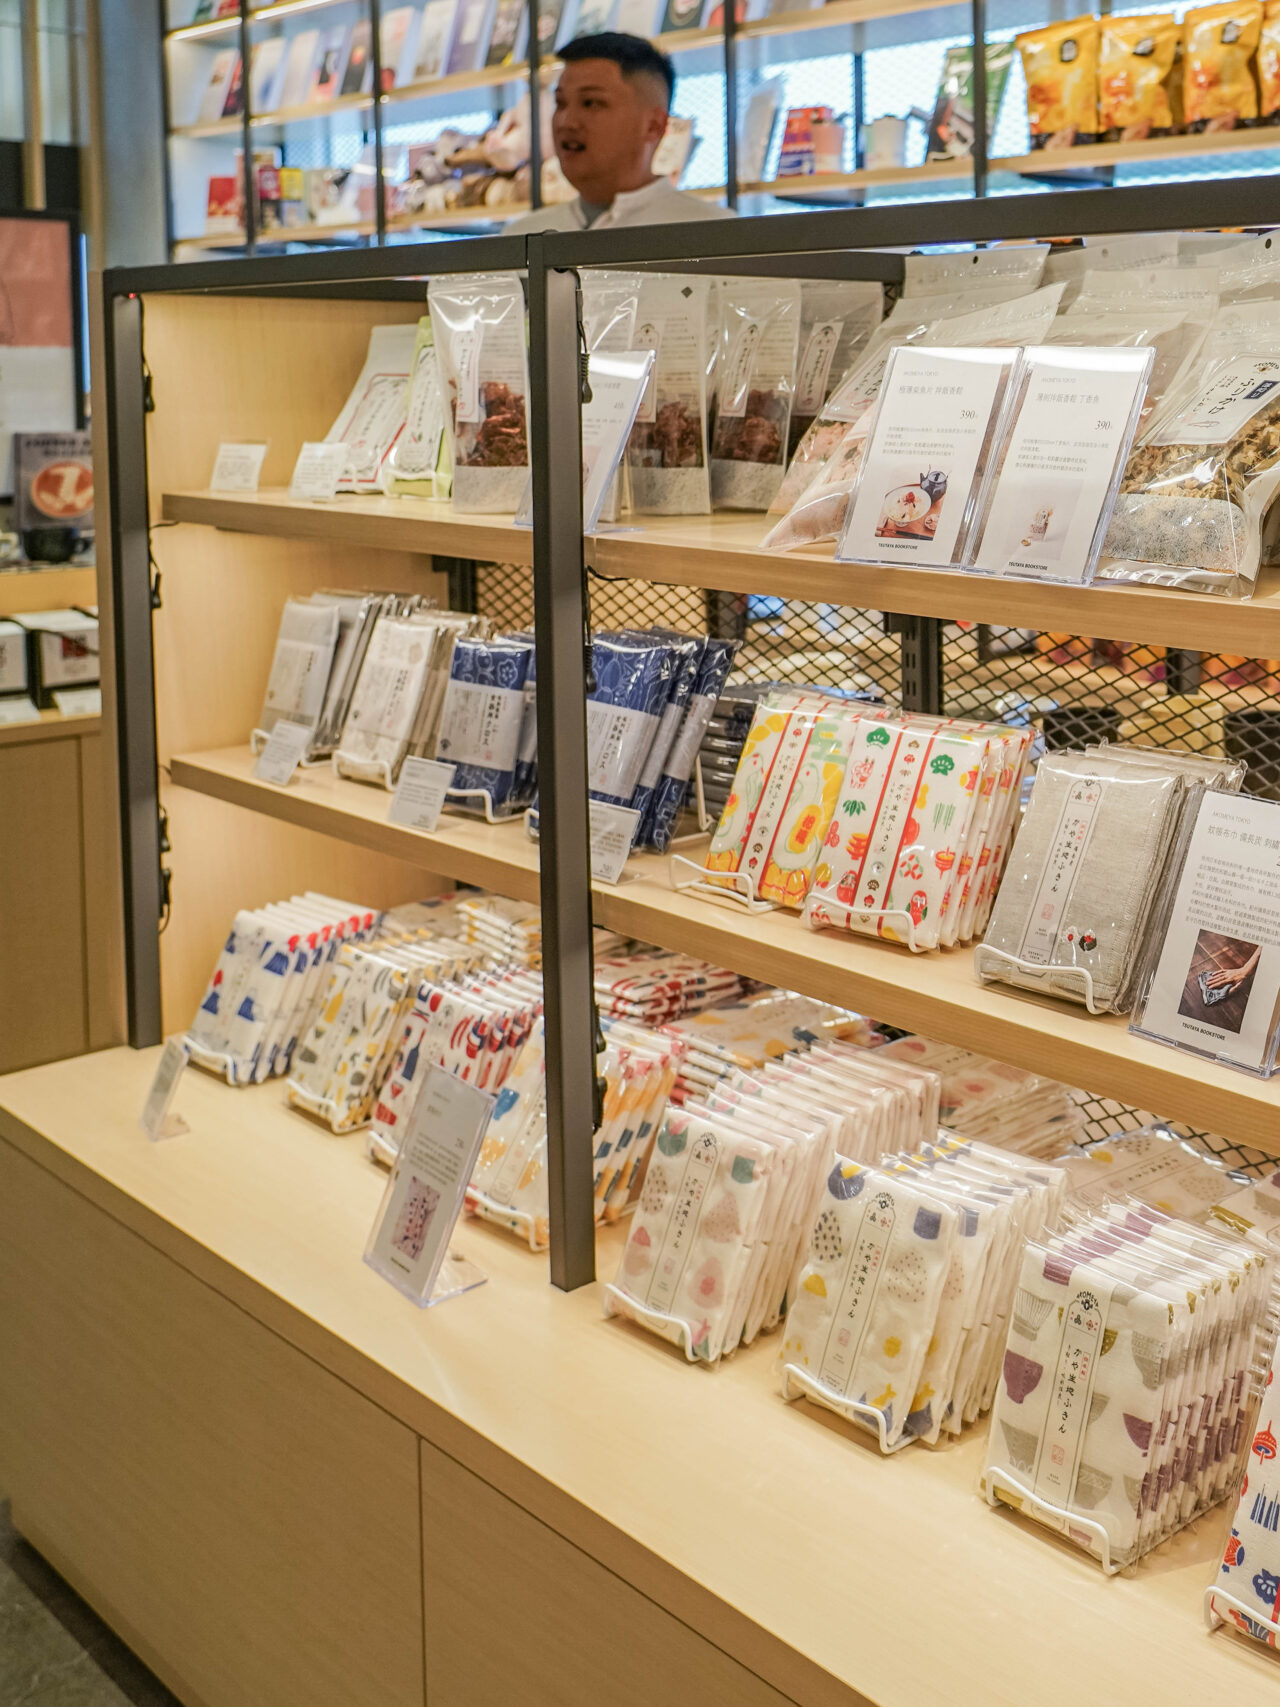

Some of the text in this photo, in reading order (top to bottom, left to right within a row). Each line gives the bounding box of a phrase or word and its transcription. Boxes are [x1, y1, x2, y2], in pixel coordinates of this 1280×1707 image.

[1208, 378, 1255, 415] ふりかけ
[960, 410, 975, 419] 390
[1095, 421, 1111, 430] 390
[1182, 1022, 1225, 1041] TSUTAYA BOOKSTORE
[1058, 1349, 1082, 1434] かや生地ふきん
